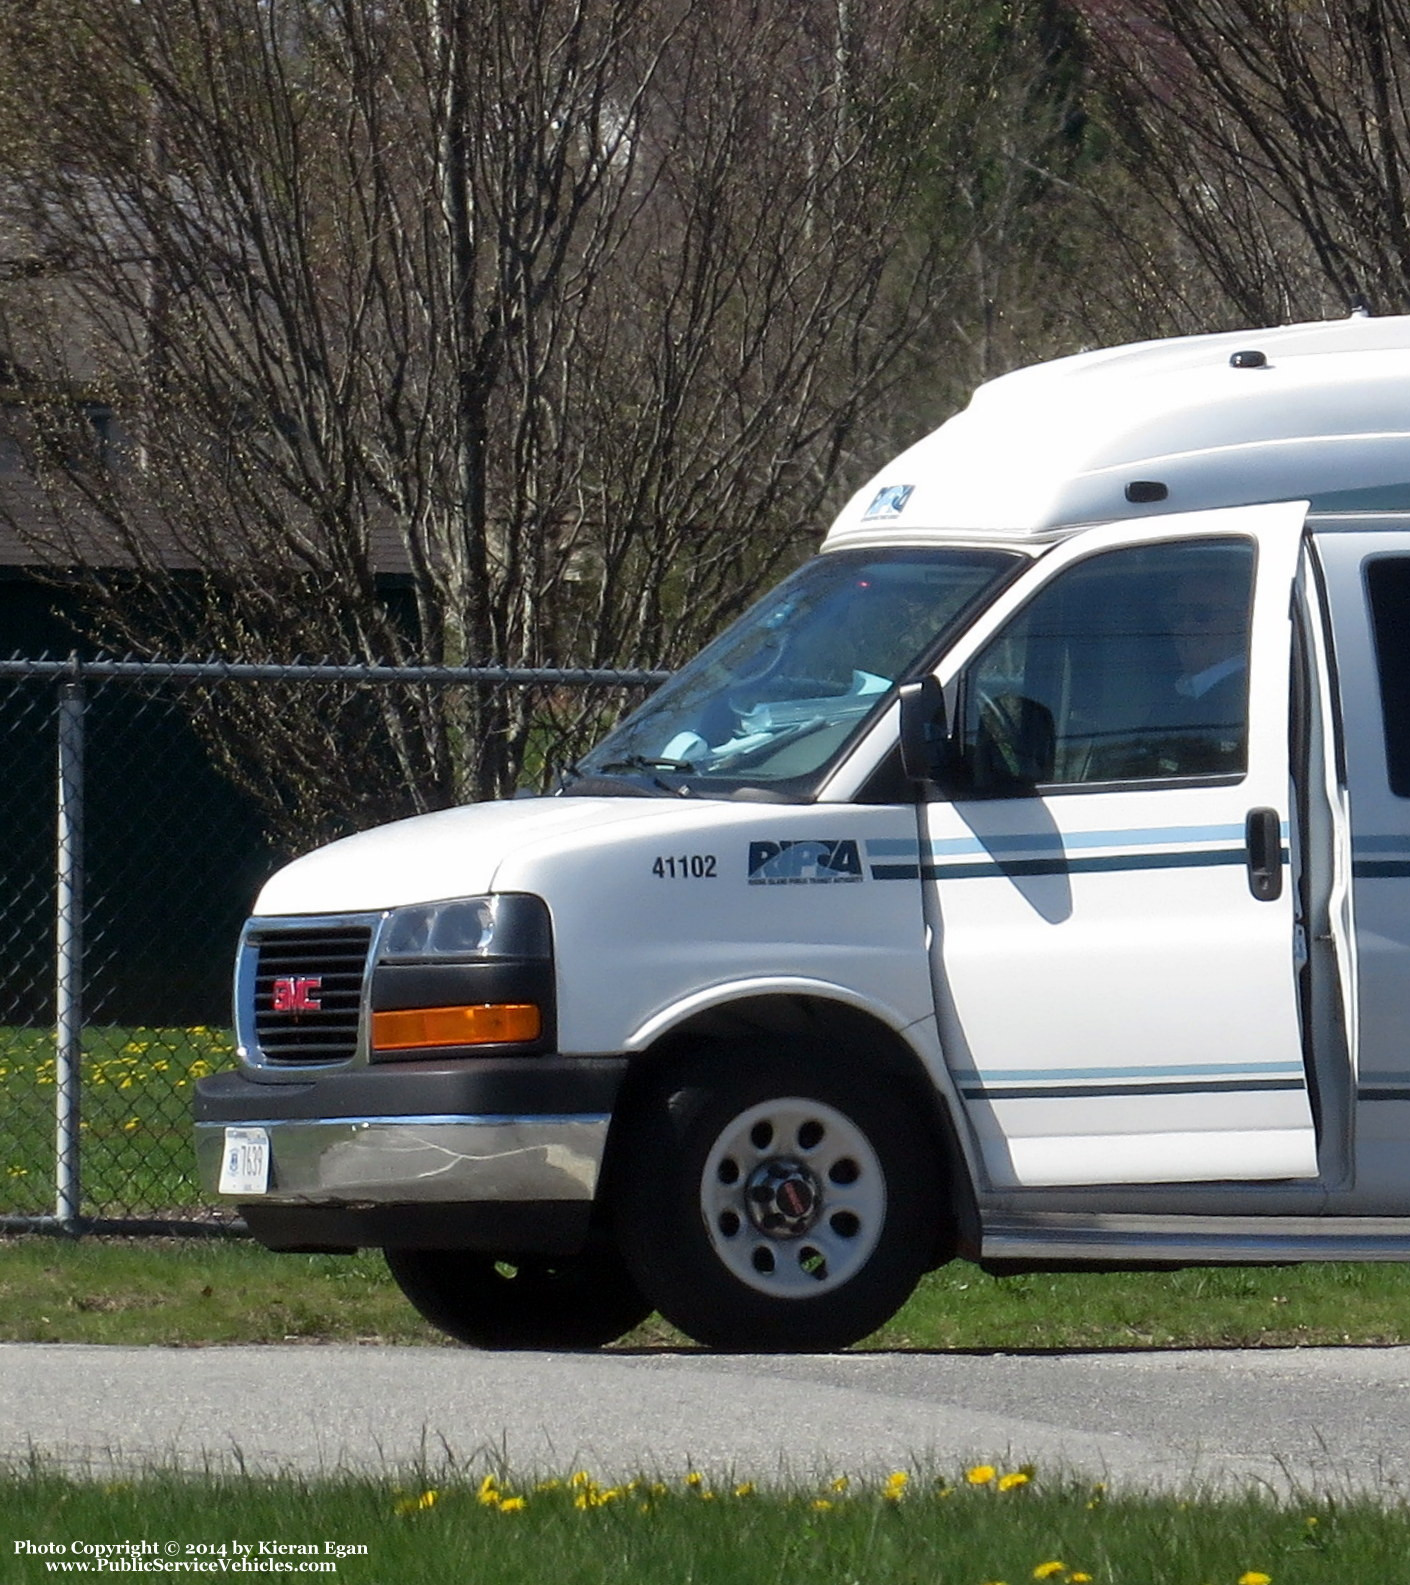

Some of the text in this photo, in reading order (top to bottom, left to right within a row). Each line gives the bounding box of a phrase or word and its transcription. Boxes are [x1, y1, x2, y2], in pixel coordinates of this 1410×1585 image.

[652, 855, 717, 878] 41102
[273, 976, 322, 1011] GMC
[241, 1145, 263, 1176] 7639
